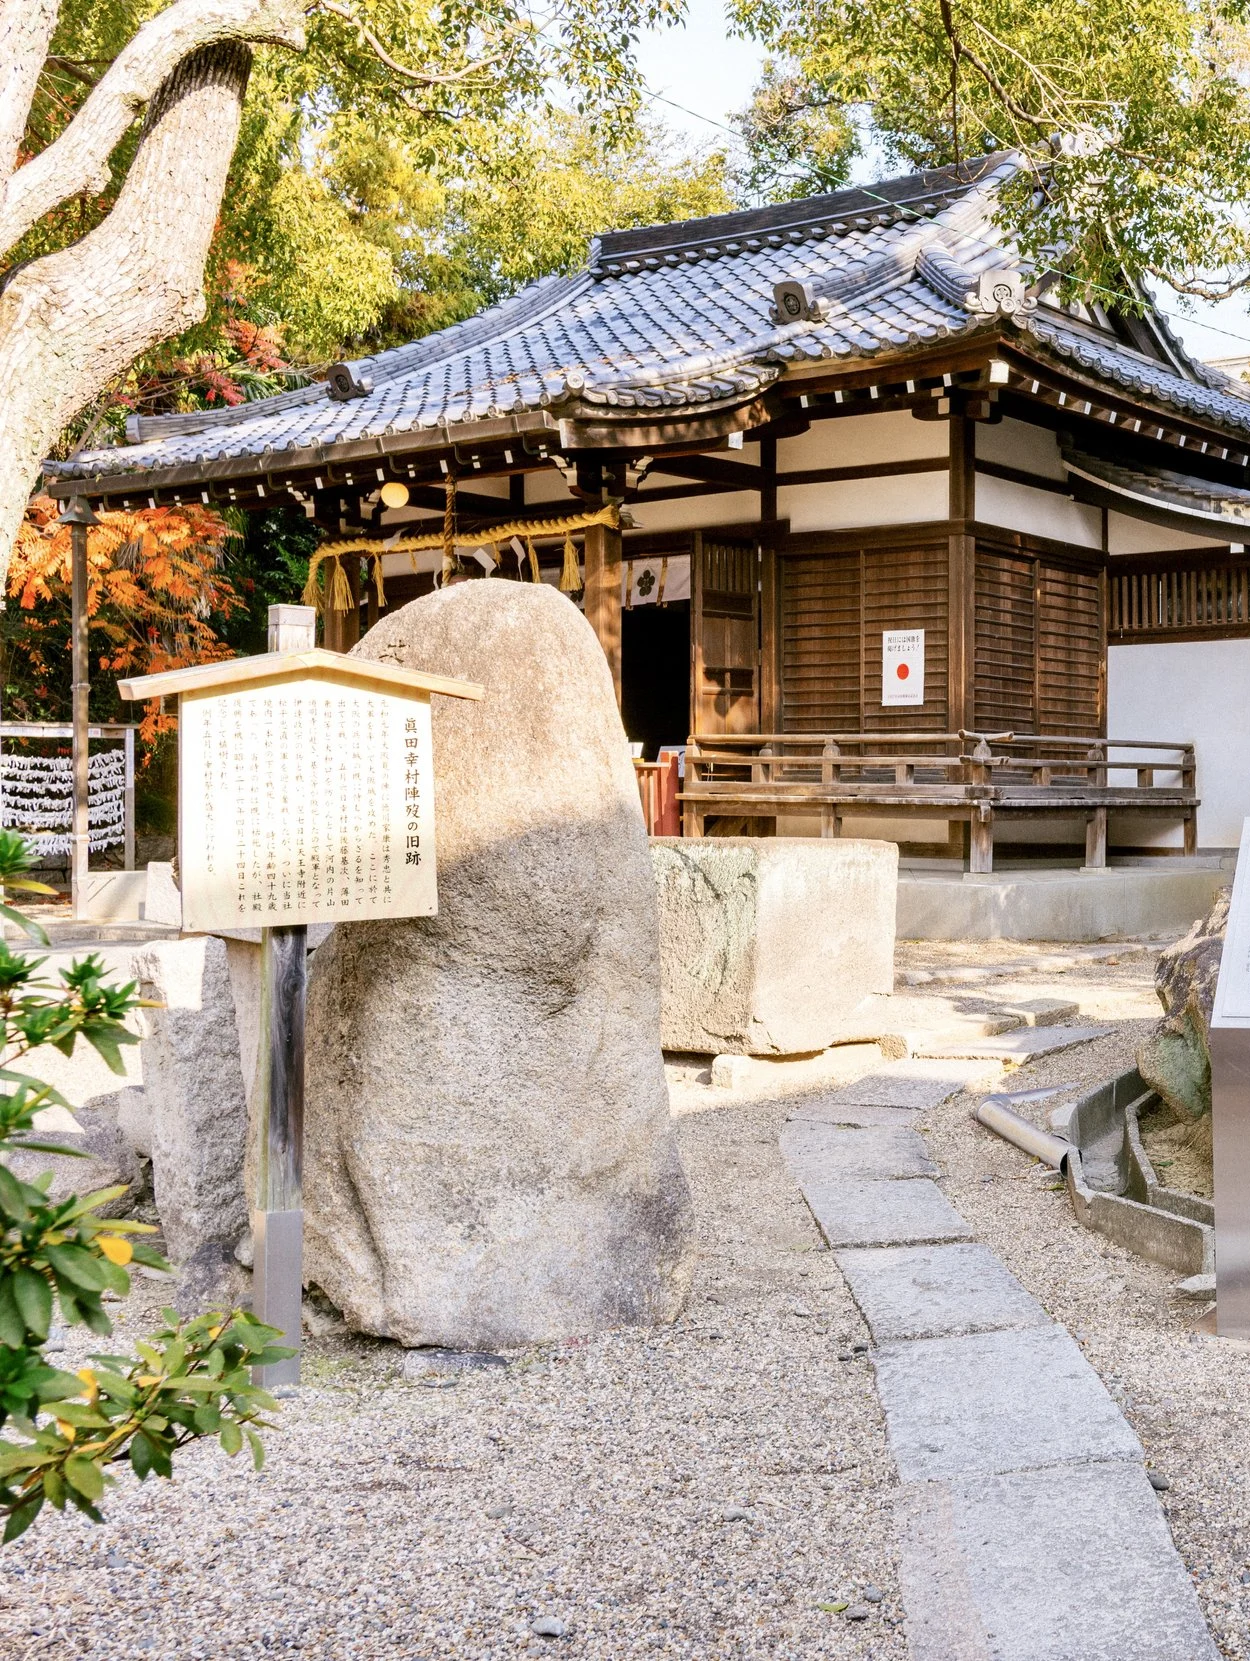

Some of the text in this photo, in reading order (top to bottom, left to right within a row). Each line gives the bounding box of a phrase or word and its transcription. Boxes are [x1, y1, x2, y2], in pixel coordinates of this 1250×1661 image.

[403, 718, 422, 865] 眞田幸村陣歿の旧跡
